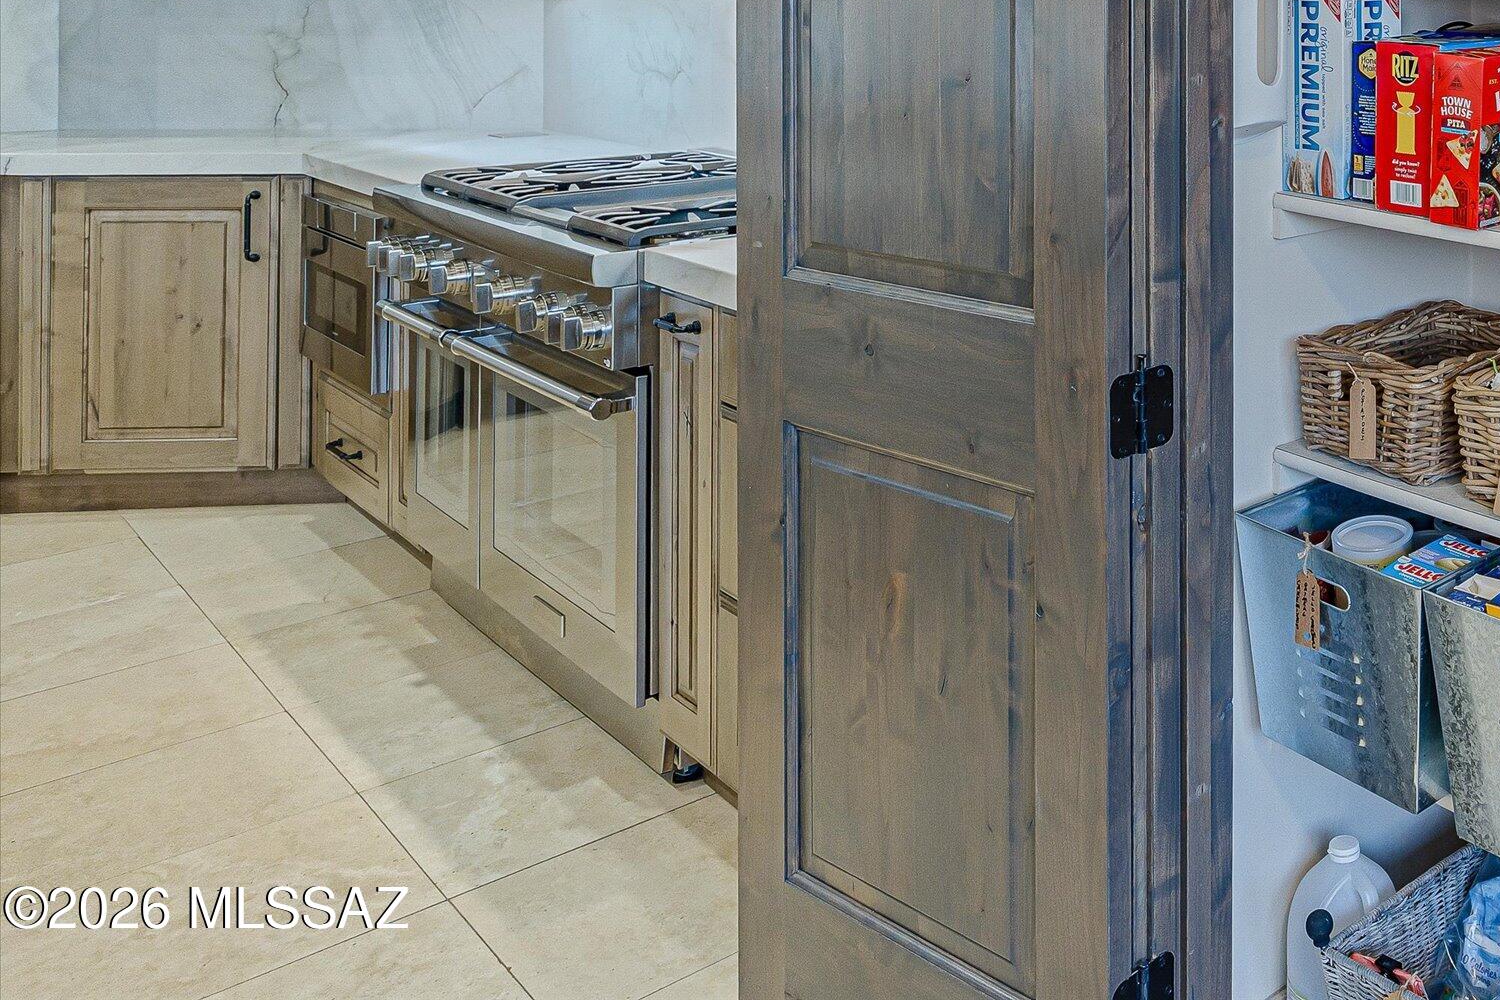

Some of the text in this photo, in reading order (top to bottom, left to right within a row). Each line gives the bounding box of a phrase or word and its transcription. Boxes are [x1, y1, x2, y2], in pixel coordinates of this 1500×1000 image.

[1315, 26, 1334, 72] original
[1301, 0, 1320, 152] PREMIUM
[1392, 53, 1419, 79] RITZ
[1441, 96, 1472, 109] TOWN
[1440, 106, 1474, 120] HOUSE
[1446, 118, 1466, 129] PITA
